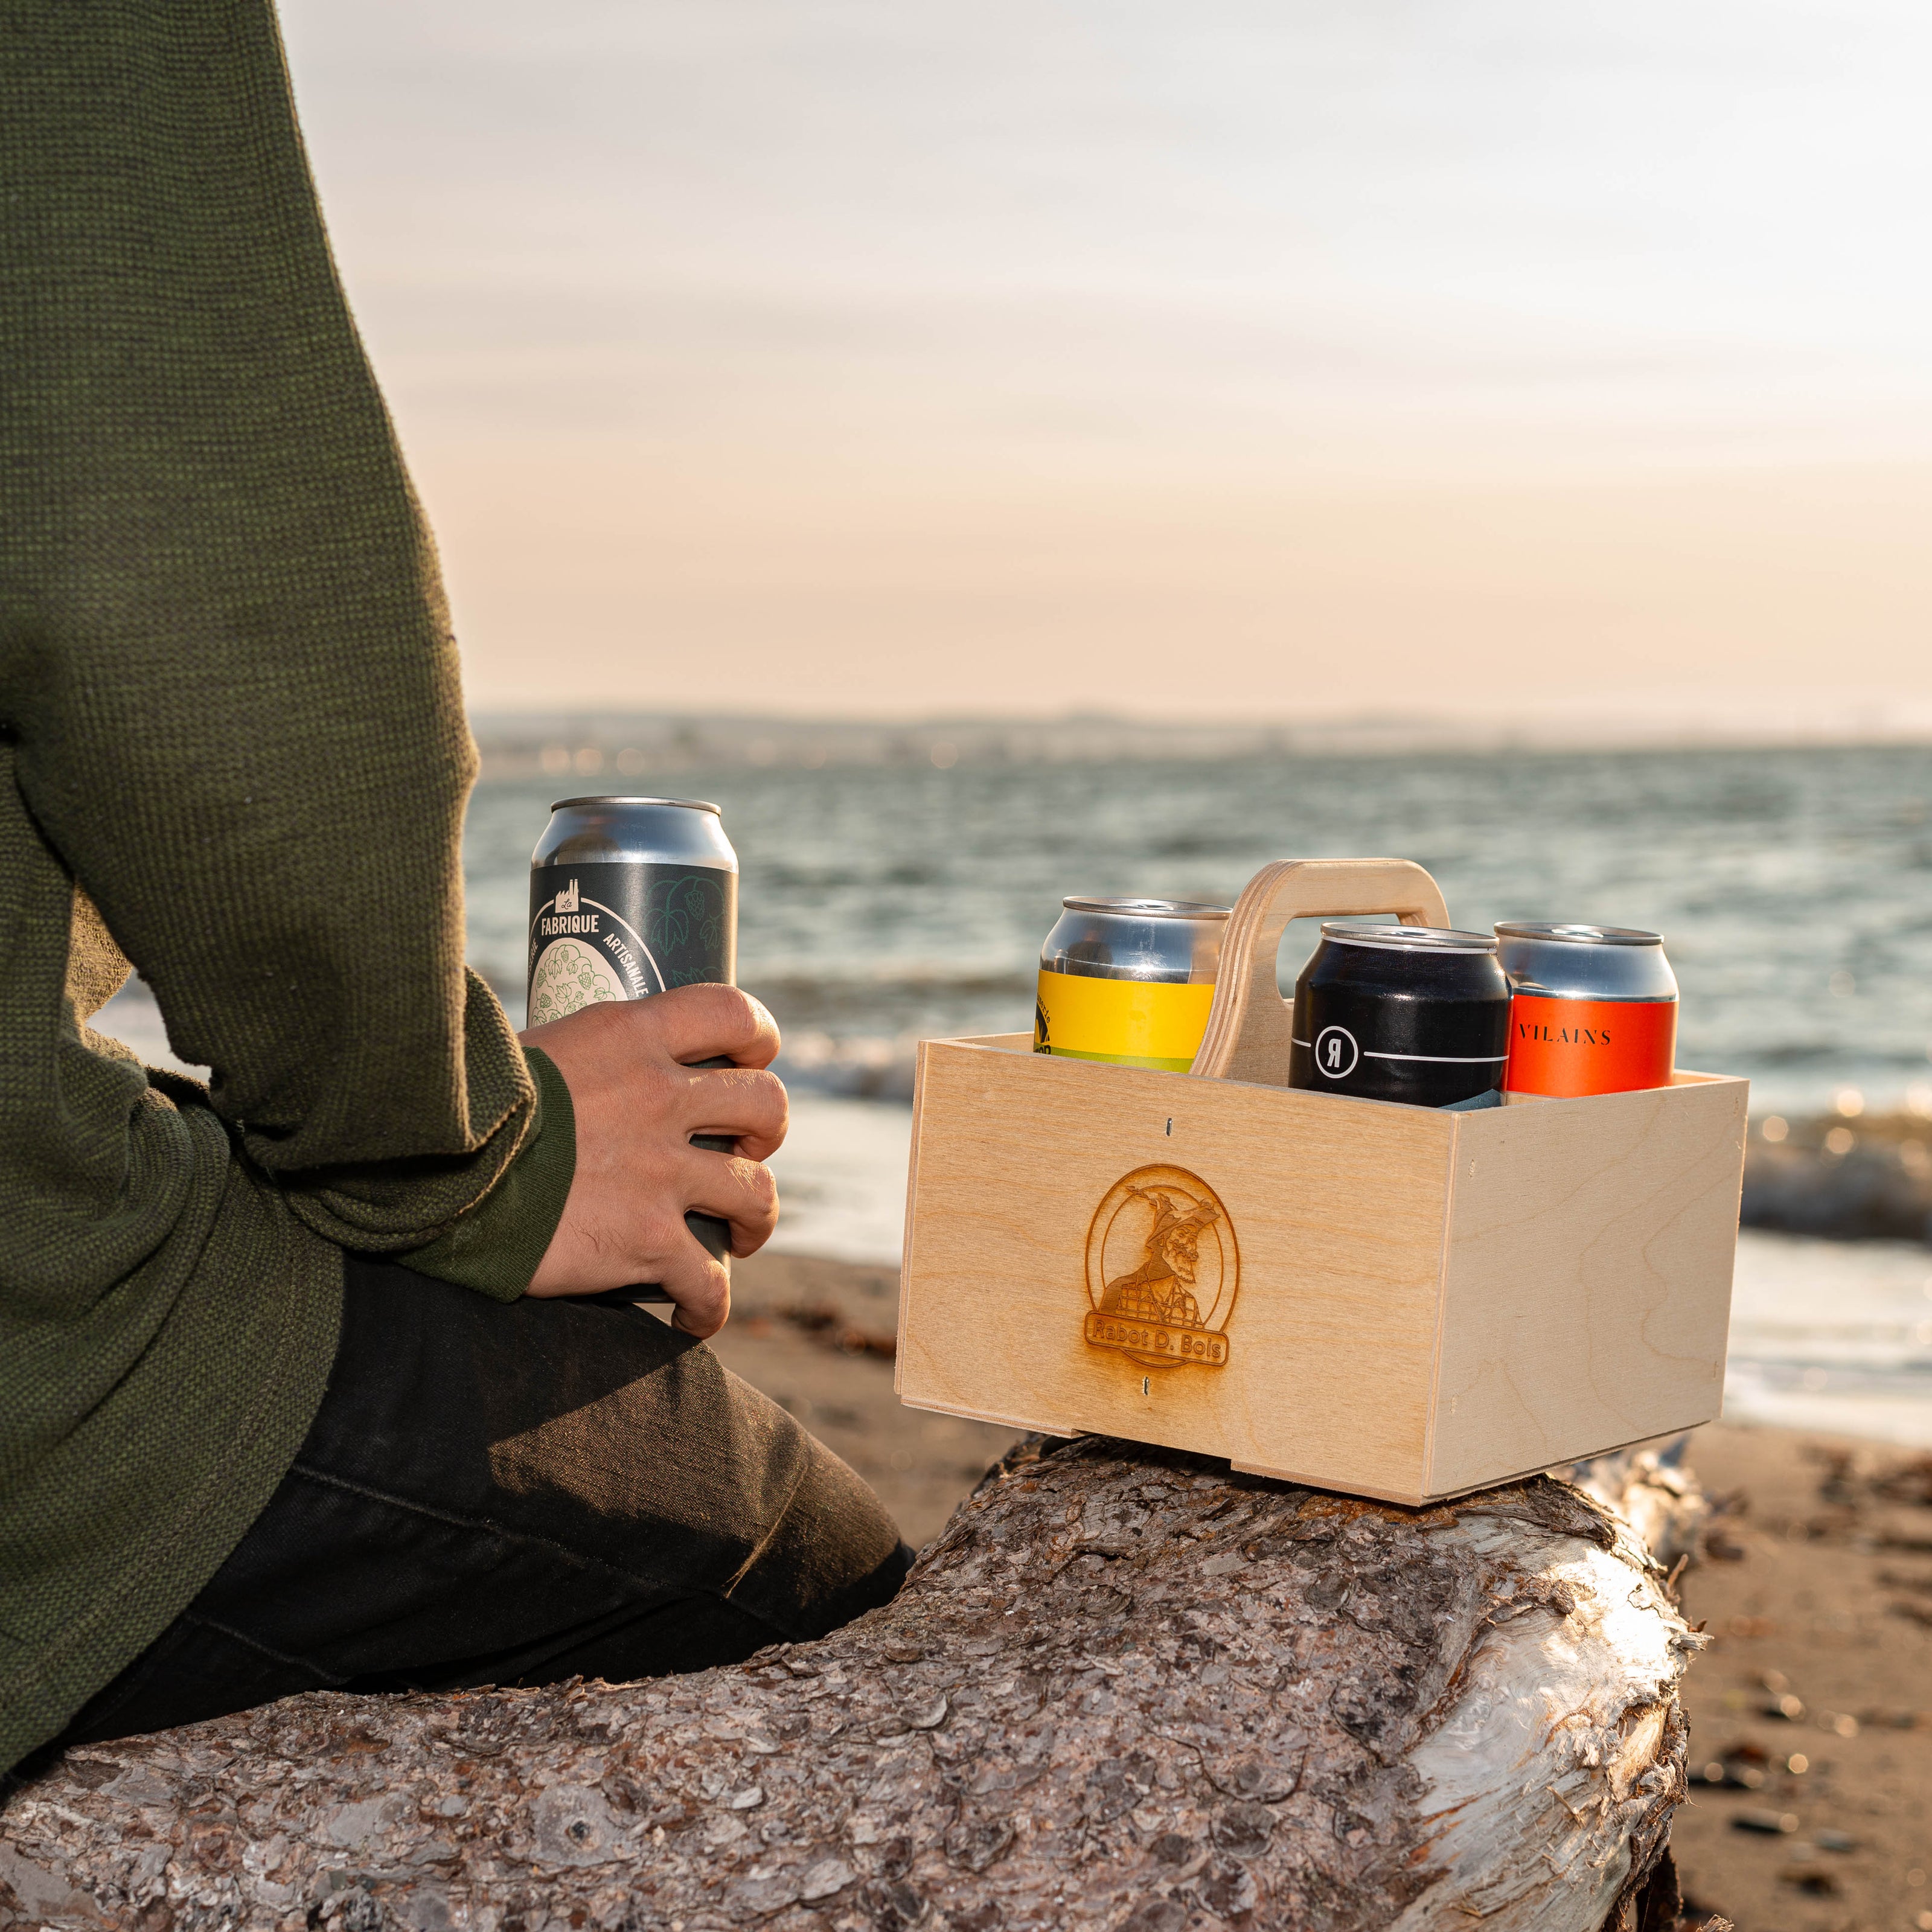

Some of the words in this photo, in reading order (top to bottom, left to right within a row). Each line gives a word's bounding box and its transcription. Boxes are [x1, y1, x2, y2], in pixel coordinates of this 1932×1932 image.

[561, 898, 573, 910] La
[541, 914, 600, 936] FABRIQUE
[603, 933, 649, 997] ARTISANALE
[1519, 1023, 1611, 1046] VILAINS
[1093, 1319, 1149, 1346] Rabot
[1154, 1329, 1174, 1351] D.
[1180, 1334, 1221, 1358] Bois
